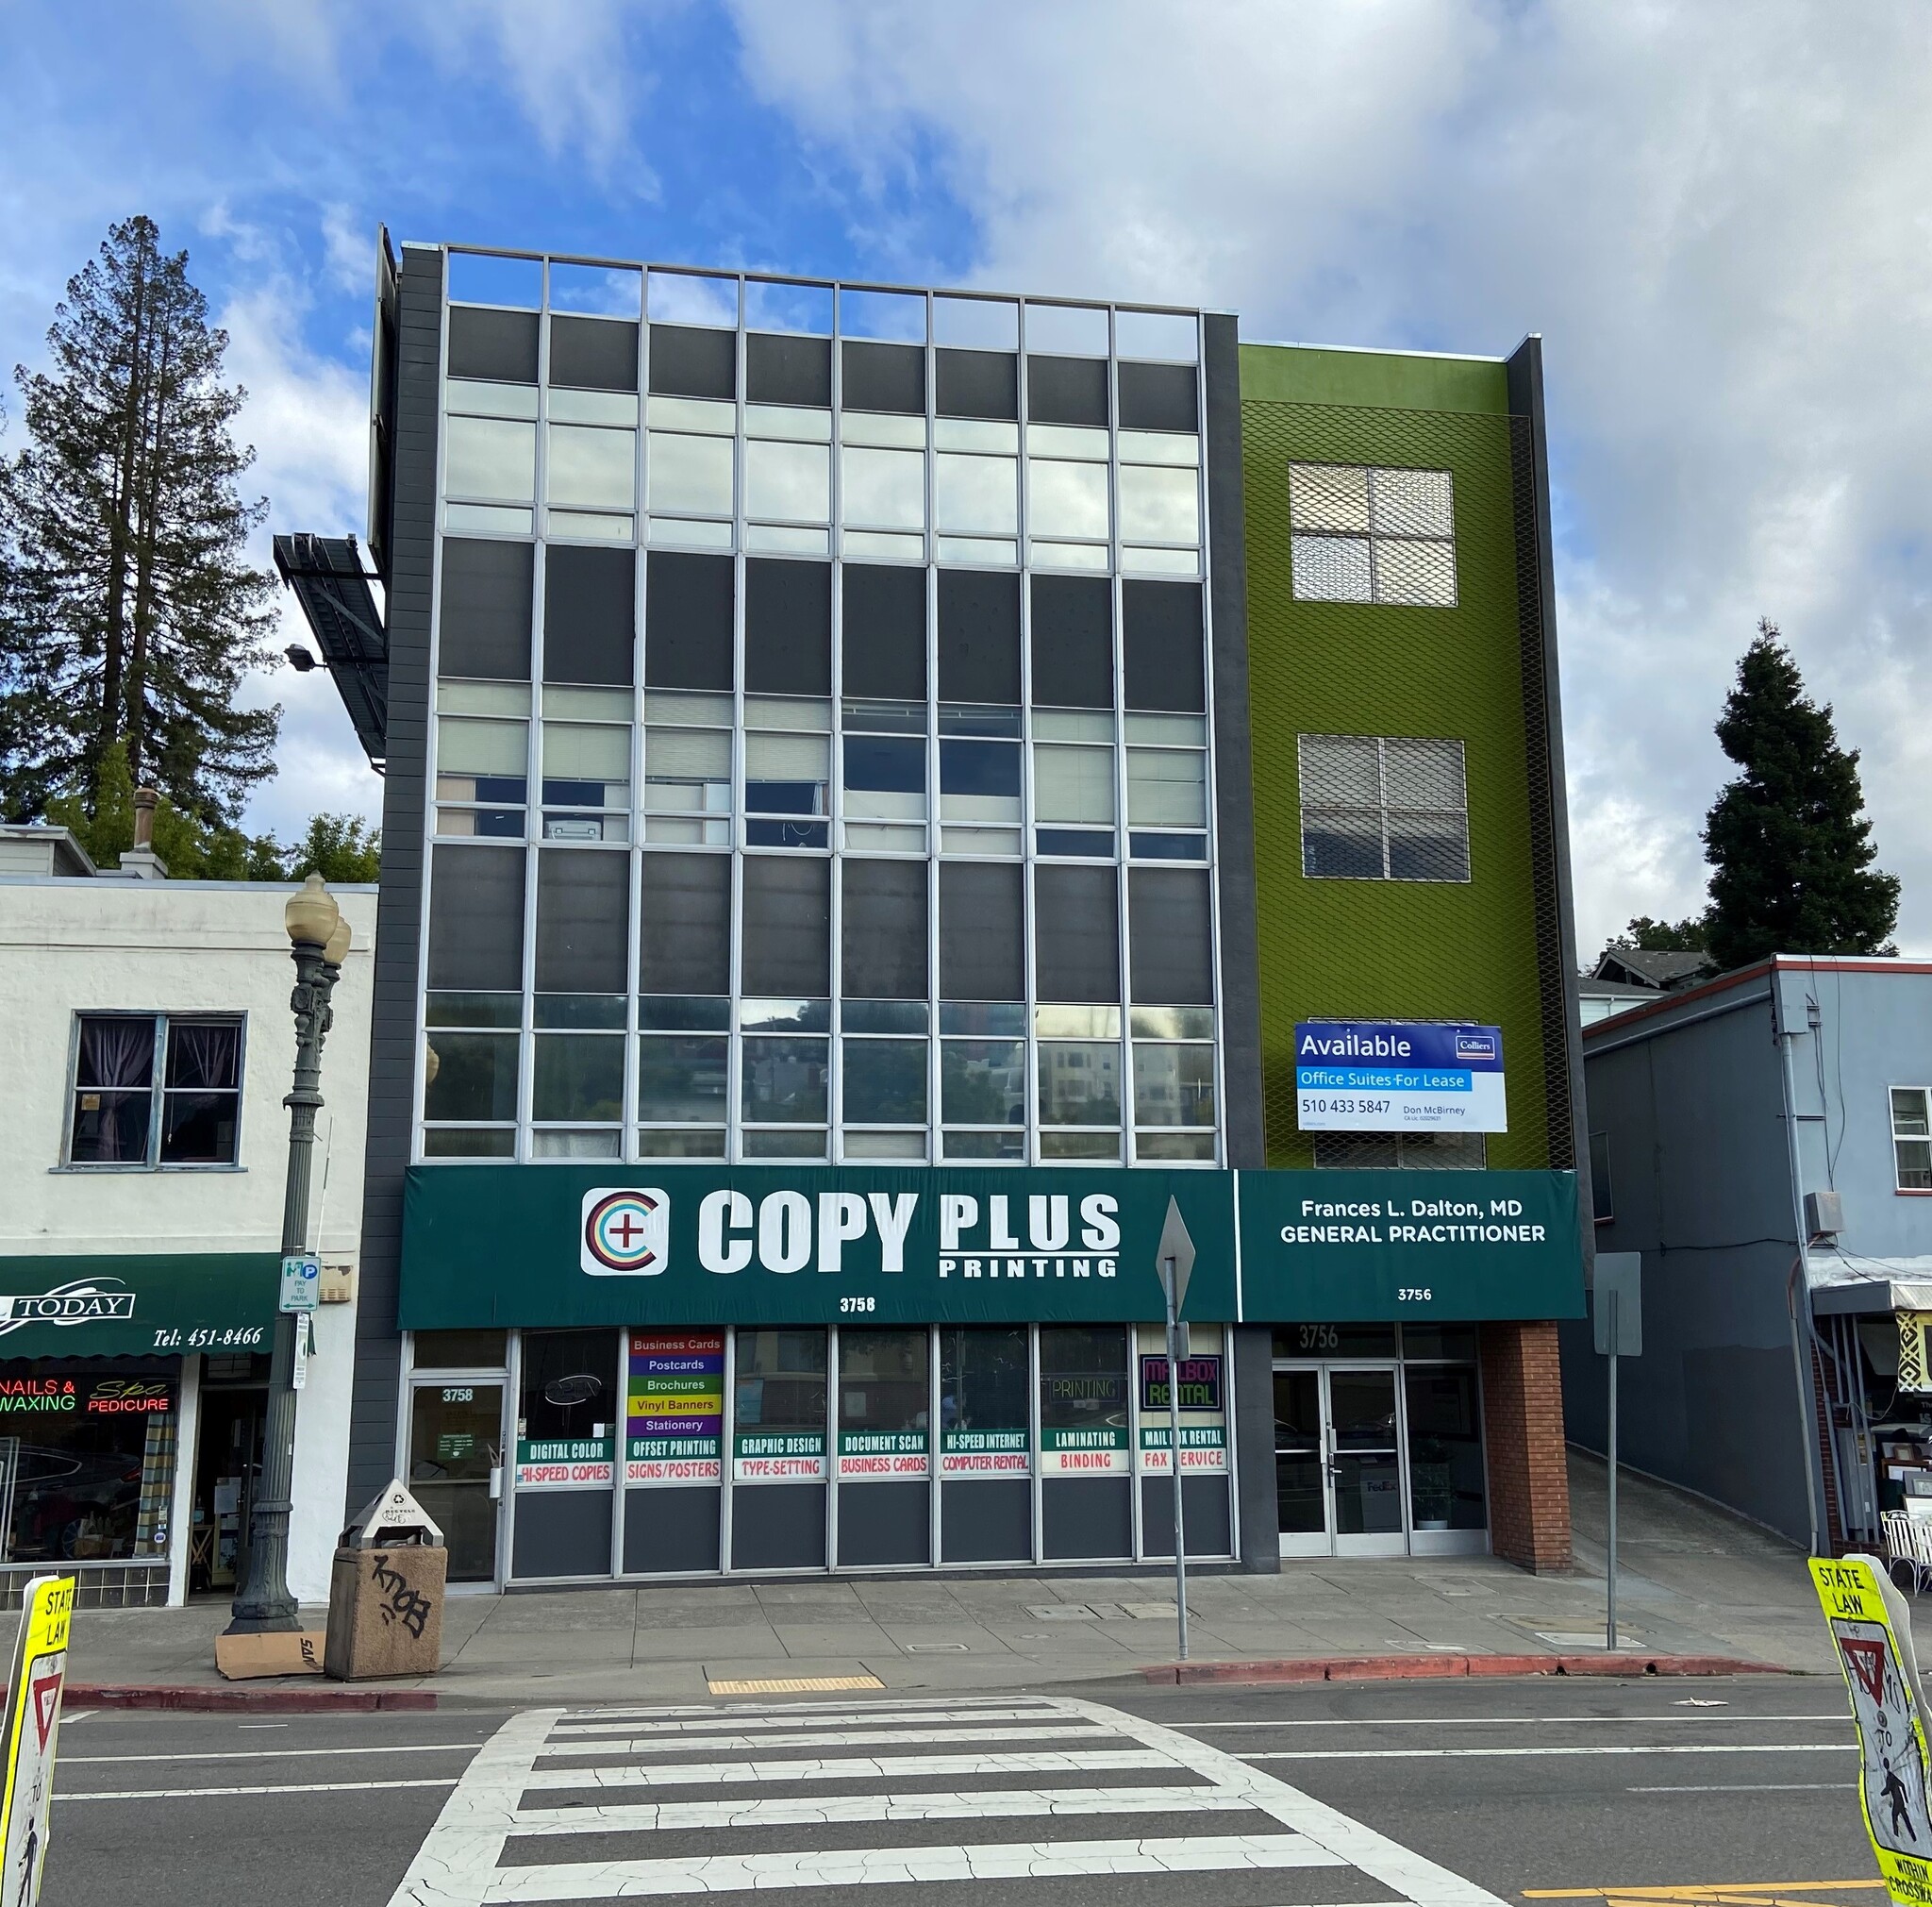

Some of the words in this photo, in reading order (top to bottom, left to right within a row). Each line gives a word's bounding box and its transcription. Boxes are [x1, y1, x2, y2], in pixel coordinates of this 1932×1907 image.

[1300, 1034, 1411, 1058] Available
[1460, 1040, 1491, 1051] Colliers
[1301, 1071, 1344, 1085] Office
[1348, 1072, 1391, 1086] Suites
[1396, 1074, 1420, 1086] For
[1424, 1075, 1465, 1087] Lease
[1302, 1099, 1326, 1112] 510
[1330, 1100, 1355, 1112] 433
[1358, 1100, 1391, 1113] 5847
[1403, 1106, 1422, 1114] Don
[1424, 1106, 1466, 1116] McBirney
[1301, 1200, 1381, 1217] Frances
[1387, 1201, 1405, 1217] L.
[1411, 1199, 1484, 1219] Dalton,
[1491, 1200, 1523, 1216] MD
[940, 1194, 1121, 1251] PLUS
[698, 1190, 919, 1274] COPY
[1280, 1226, 1382, 1243] GENERAL
[1389, 1226, 1546, 1242] PRACTITIONER
[939, 1259, 1116, 1278] PRINTING
[1397, 1288, 1432, 1300] 3756
[18, 1297, 125, 1316] TODAY
[840, 1296, 875, 1313] 3758
[153, 1329, 181, 1347] Tel:
[188, 1327, 264, 1347] 451-8466
[634, 1341, 685, 1350] Business
[688, 1340, 721, 1349] Cards
[1299, 1325, 1339, 1348] 3756
[649, 1360, 705, 1370] Postcards
[1145, 1361, 1218, 1381] MALBOX
[0, 1380, 58, 1395] NAILS
[63, 1380, 75, 1394] &
[90, 1380, 168, 1399] Spa
[647, 1380, 705, 1391] Brochures
[1052, 1380, 1116, 1398] PRINTING
[442, 1389, 474, 1402] 3758
[88, 1398, 169, 1412] PEDICURE
[637, 1400, 665, 1413] Vinyl
[668, 1400, 714, 1410] Banners
[645, 1420, 704, 1431] Stationery
[741, 1438, 784, 1454] GRAPHIC
[787, 1437, 822, 1453] DESIGN
[845, 1436, 896, 1451] DOCUMENT
[898, 1435, 924, 1450] SCAN
[947, 1434, 985, 1449] HI-SPEED
[986, 1433, 1025, 1448] INTERNET
[1056, 1431, 1116, 1447] LAMINATING
[1144, 1430, 1168, 1446] MAIL
[1189, 1430, 1222, 1445] RENTAL
[530, 1445, 569, 1460] DIGITAL
[572, 1443, 604, 1458] COLOR
[633, 1442, 667, 1457] OFFSET
[670, 1440, 716, 1455] PRINTING
[841, 1458, 891, 1473] BUSINESS
[893, 1457, 926, 1472] CARDS
[943, 1455, 991, 1471] COMPUTER
[993, 1454, 1028, 1469] RENTAL
[1061, 1453, 1111, 1468] BINDING
[1144, 1452, 1168, 1466] FAX
[1180, 1451, 1223, 1465] ERVICE
[522, 1466, 569, 1482] HI-SPEED
[572, 1464, 610, 1480] COPIES
[627, 1462, 719, 1479] SIGNS/POSTERS
[741, 1459, 820, 1476] TYPE-SETTING
[1819, 1566, 1864, 1589] STATE
[45, 1588, 73, 1615] STATE
[1832, 1593, 1863, 1614] LAW
[46, 1621, 66, 1646] LAW
[1894, 1857, 1929, 1882] WITHIN
